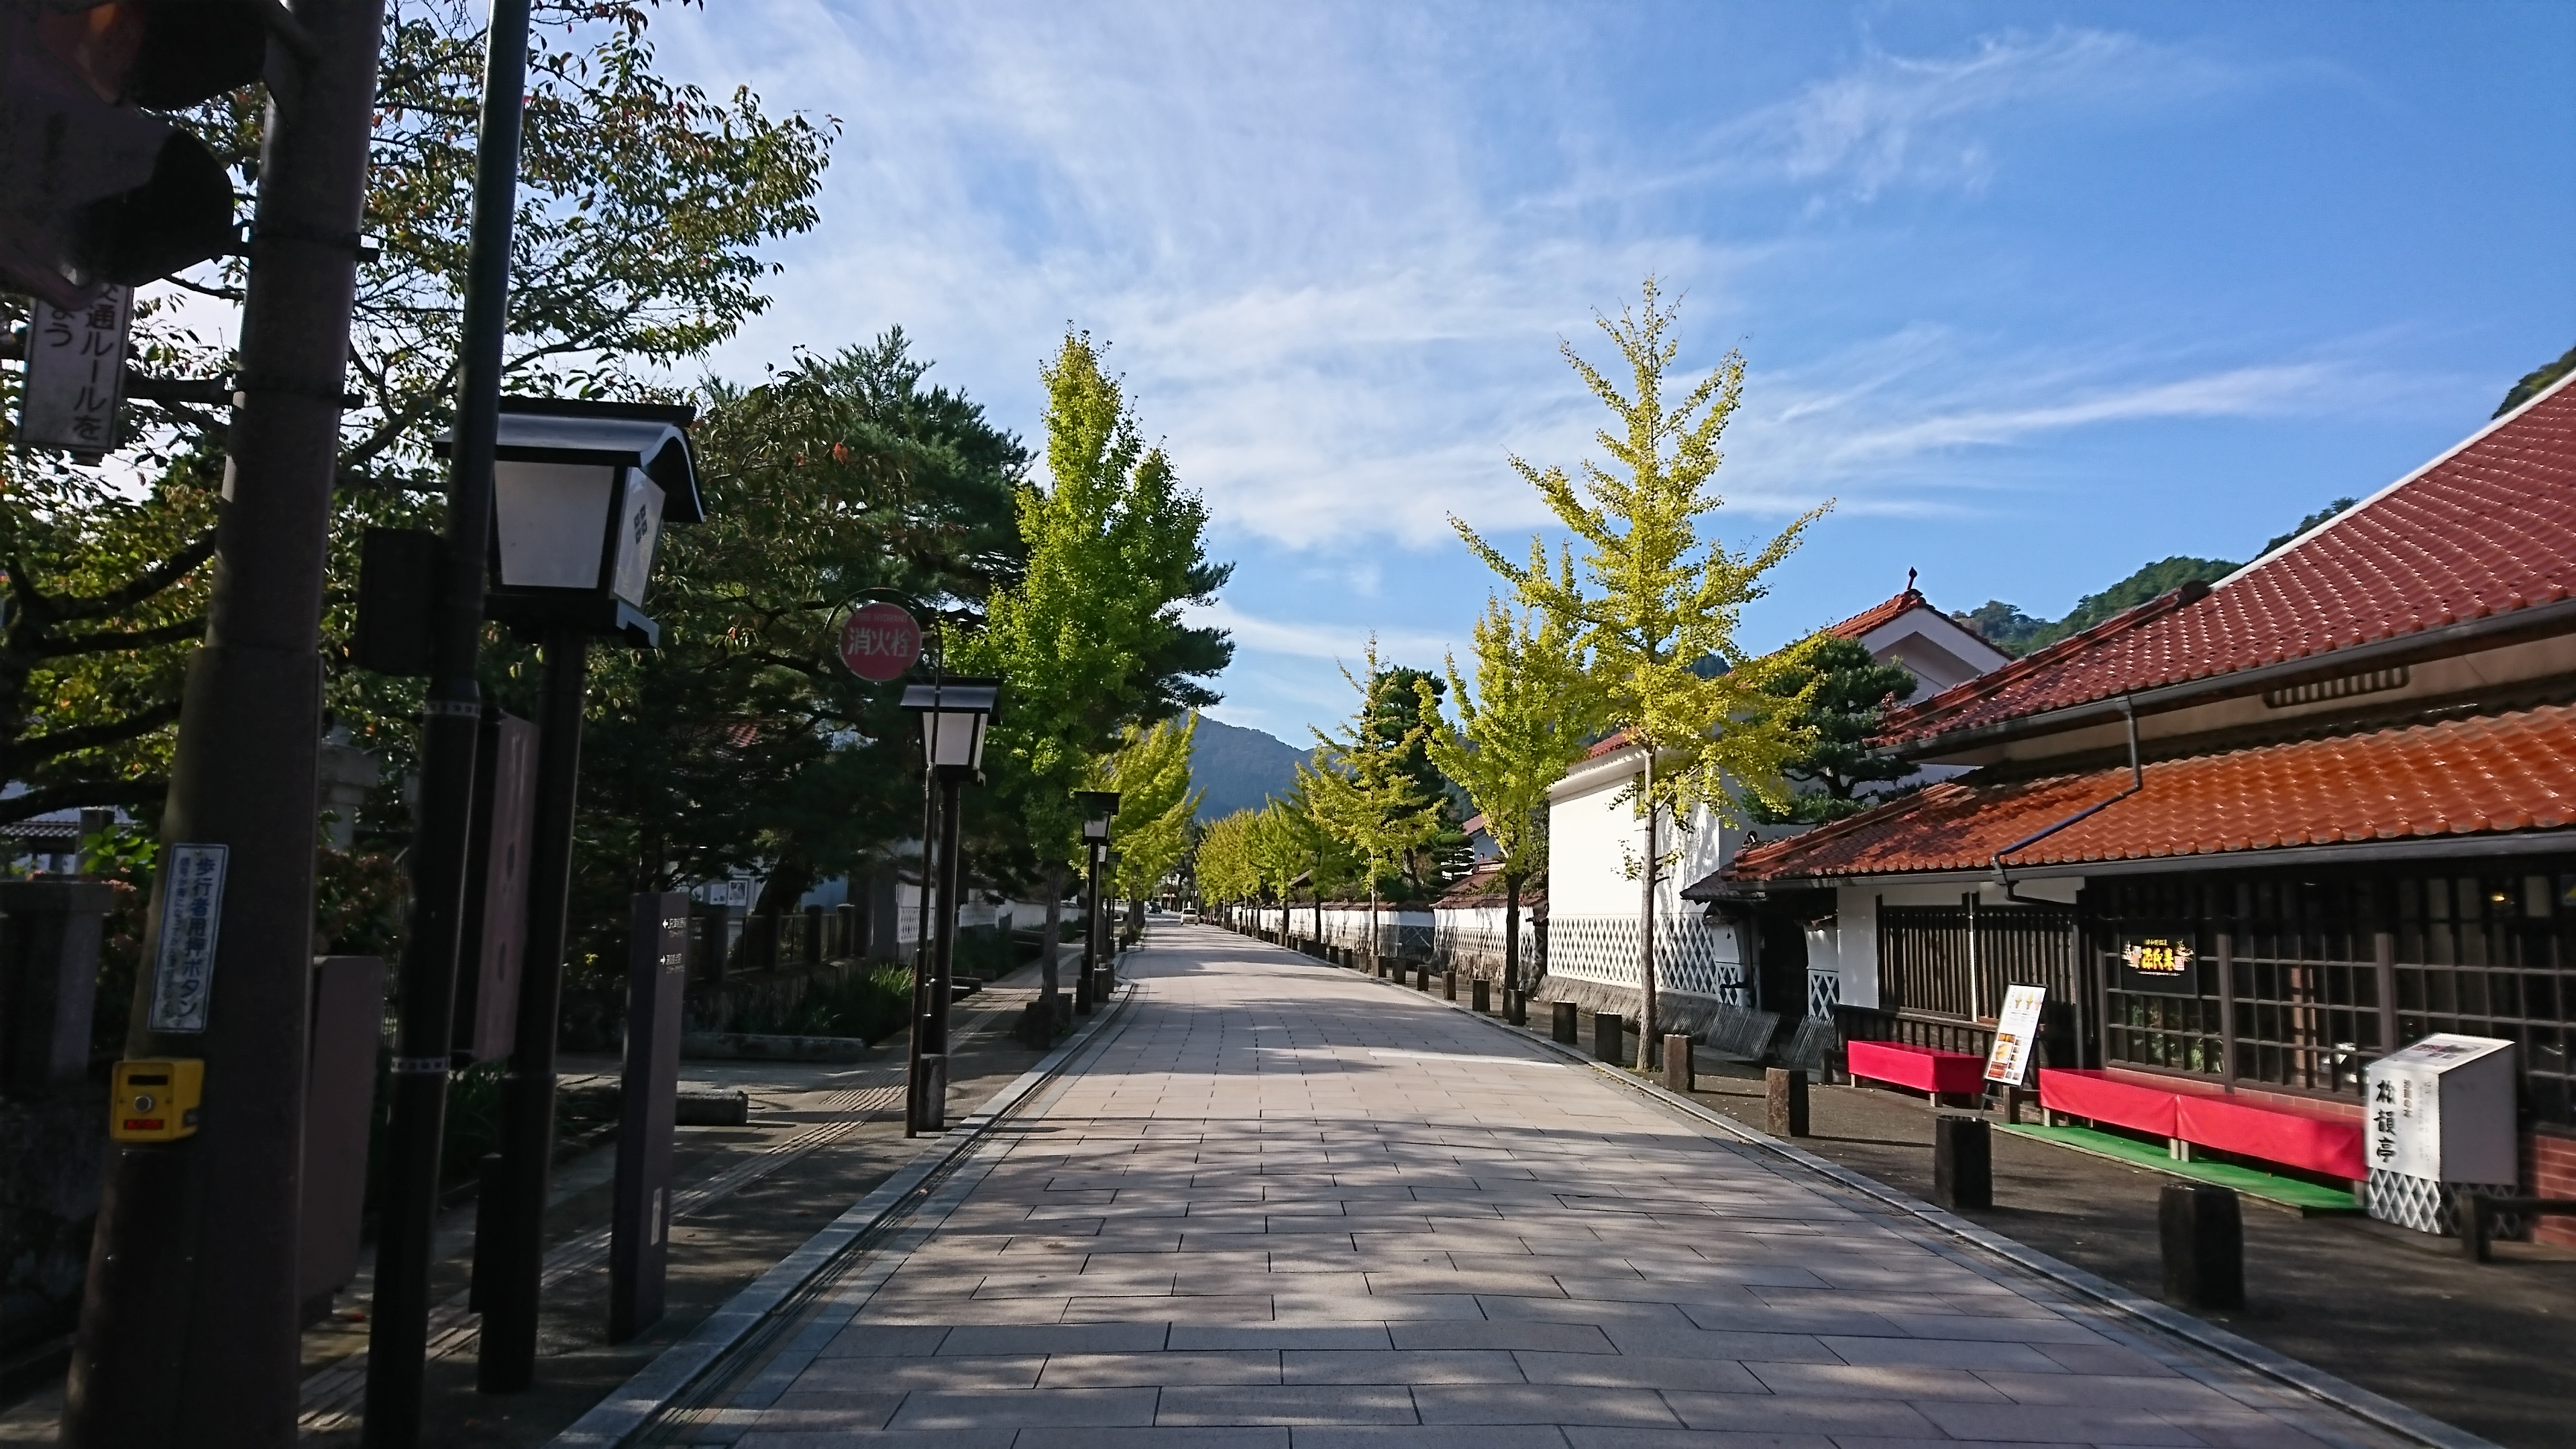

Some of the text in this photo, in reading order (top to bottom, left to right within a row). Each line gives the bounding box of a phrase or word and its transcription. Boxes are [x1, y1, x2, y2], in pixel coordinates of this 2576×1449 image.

[855, 613, 908, 623] FIRE HYDRANT
[847, 627, 914, 657] 消火栓
[178, 857, 216, 1018] 歩行者用押ボタン
